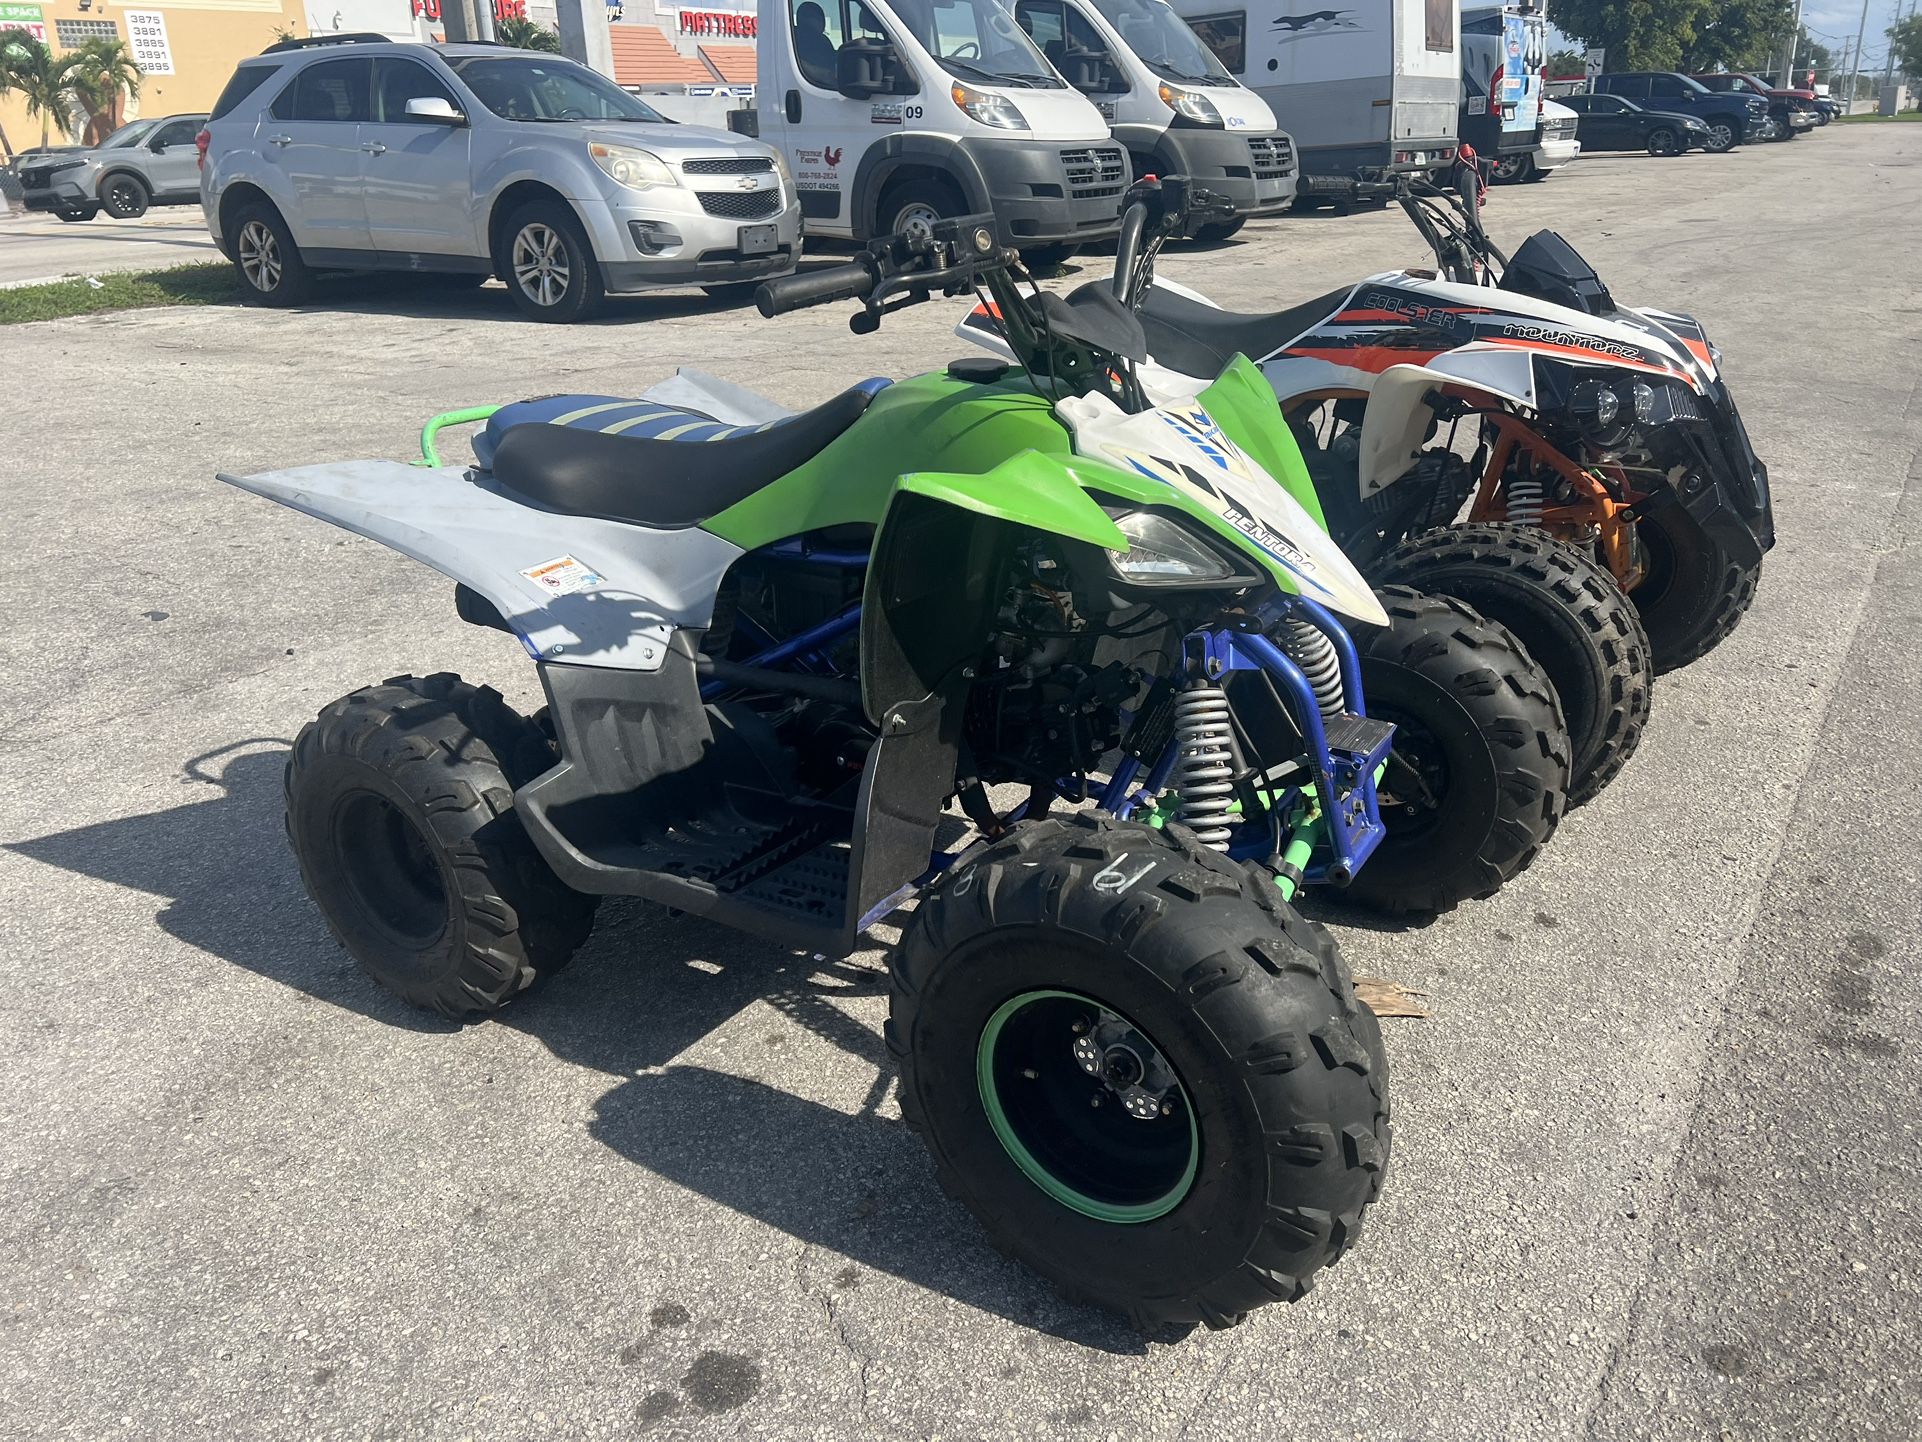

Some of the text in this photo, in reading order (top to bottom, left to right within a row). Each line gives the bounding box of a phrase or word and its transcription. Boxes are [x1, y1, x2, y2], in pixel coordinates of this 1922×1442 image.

[6, 6, 41, 16] SPACE
[130, 15, 160, 24] 3875
[133, 27, 162, 36] 3881
[135, 38, 165, 47] 3885
[138, 50, 167, 59] 3891
[140, 62, 170, 71] 3895
[905, 106, 923, 119] 09
[1363, 293, 1457, 329] COOLSTER
[1222, 507, 1317, 572] PENTORA
